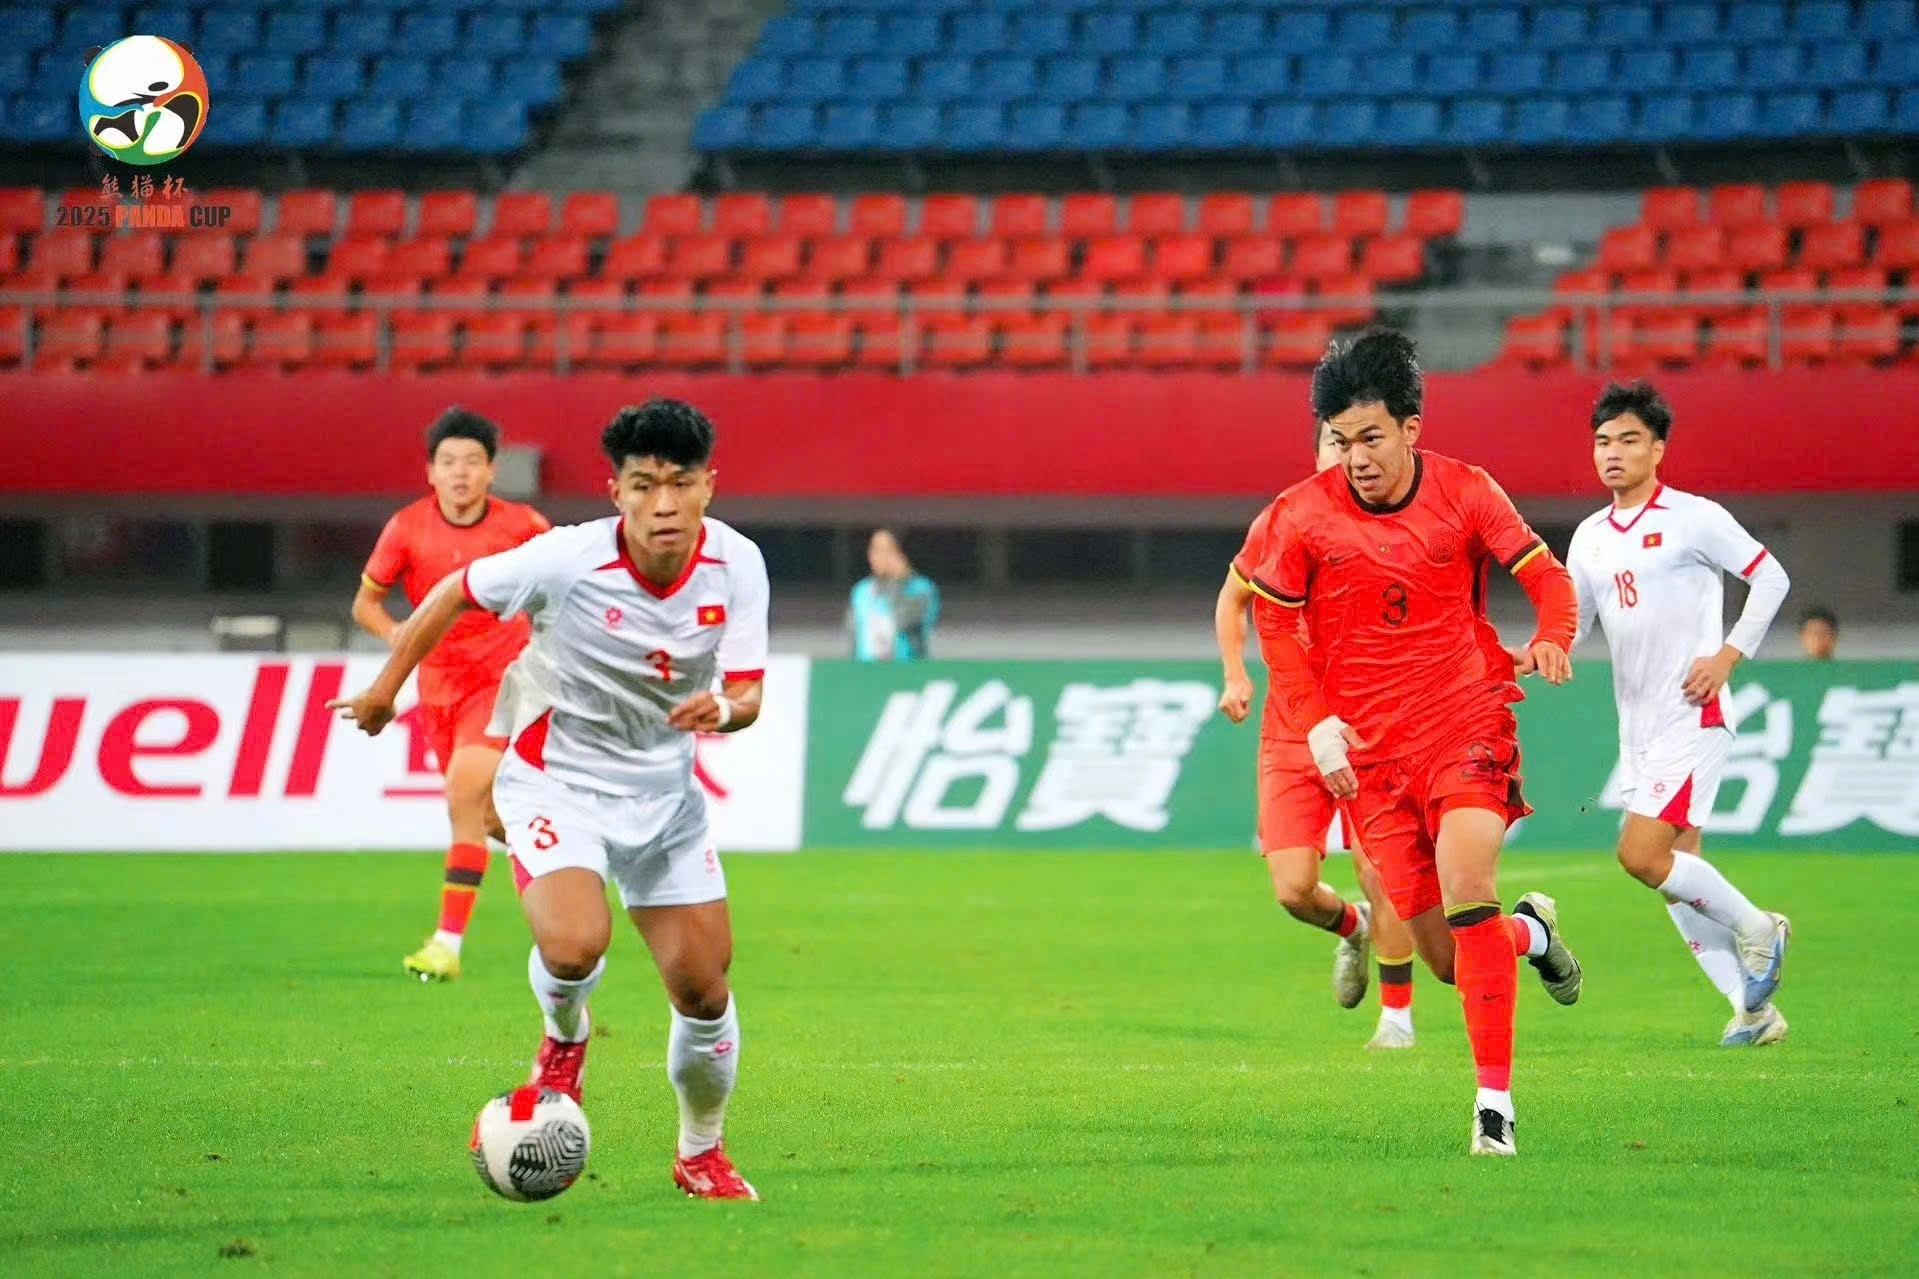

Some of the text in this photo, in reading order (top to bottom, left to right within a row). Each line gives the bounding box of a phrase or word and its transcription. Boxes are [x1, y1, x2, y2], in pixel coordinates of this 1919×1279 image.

[1381, 582, 1408, 626] 3
[1614, 569, 1638, 609] 18
[528, 815, 560, 850] 3
